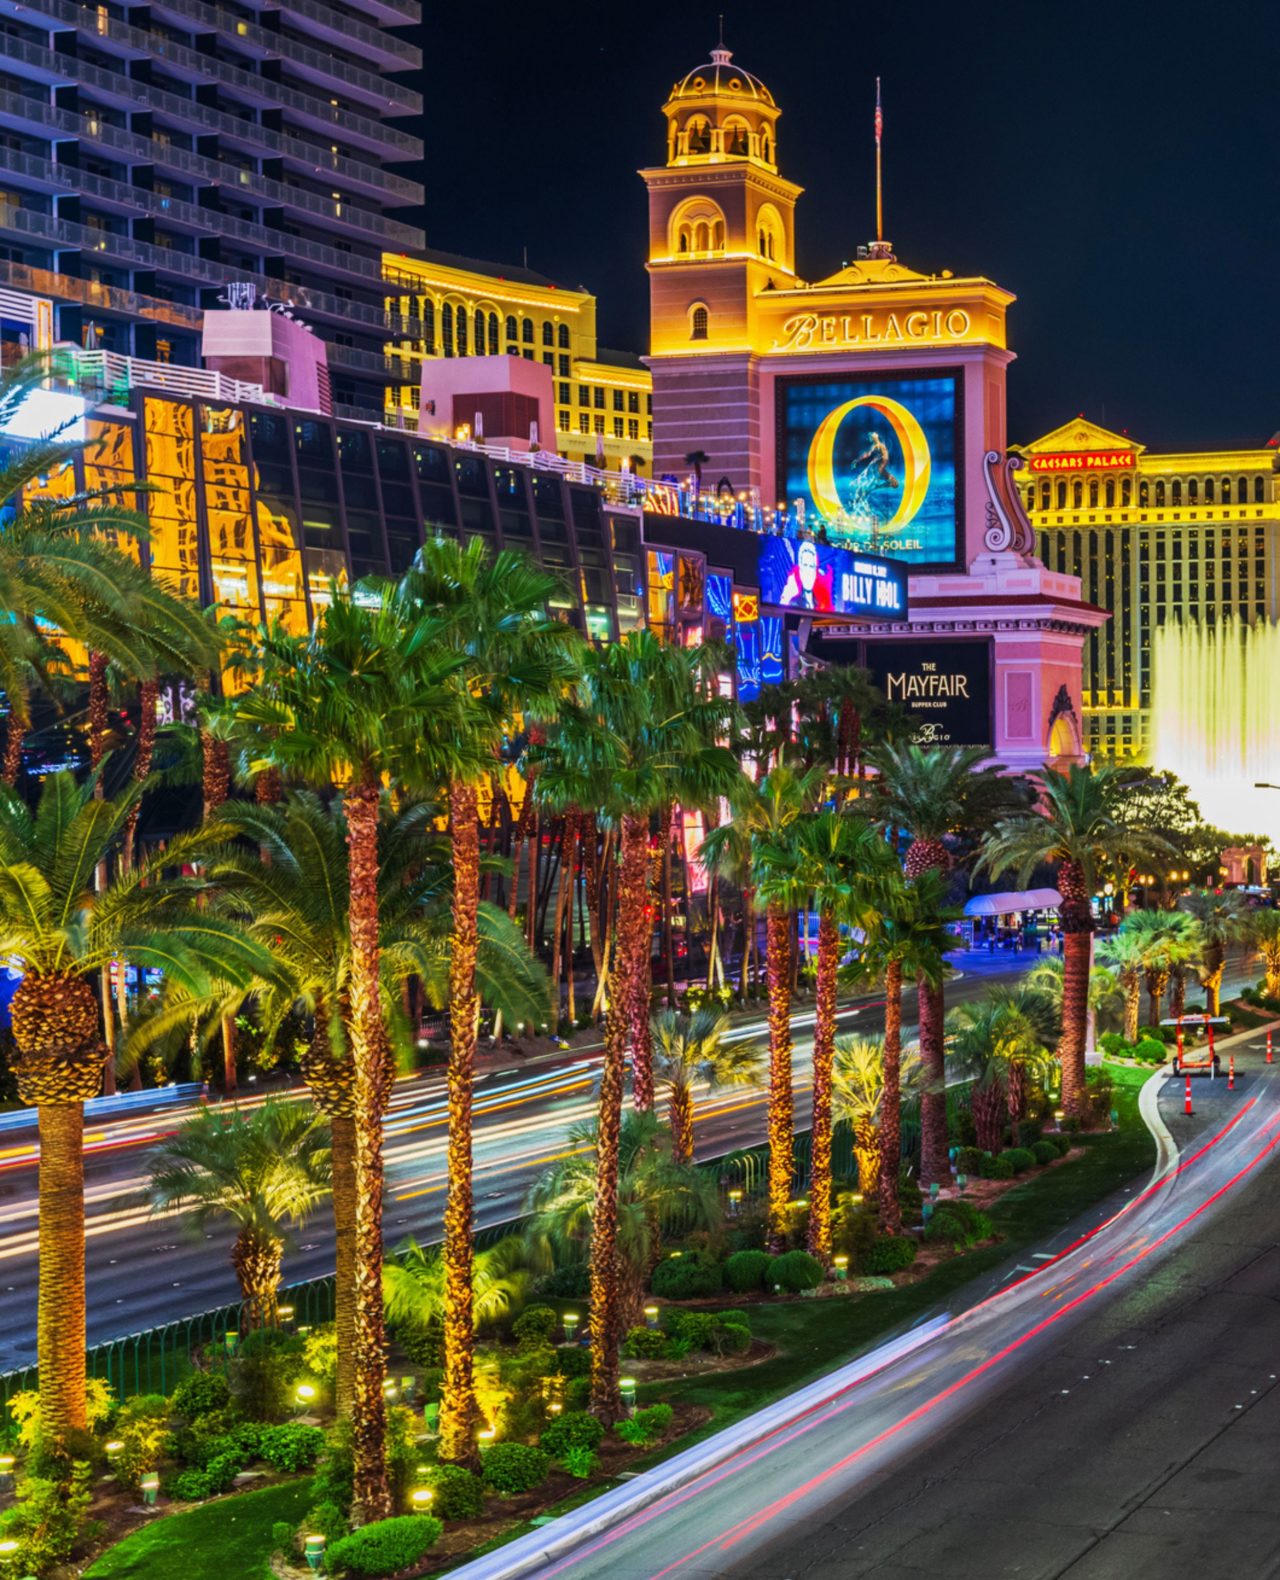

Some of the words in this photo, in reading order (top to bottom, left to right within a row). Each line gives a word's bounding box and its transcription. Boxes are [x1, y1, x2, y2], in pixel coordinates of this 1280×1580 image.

[772, 309, 971, 351] BELLAGIO
[1033, 457, 1083, 469] CAESARS
[1086, 455, 1132, 467] PALACE
[883, 539, 923, 550] SOLEIL
[841, 572, 873, 605] BILLY
[921, 662, 937, 671] THE
[887, 672, 970, 700] MAYFAIR
